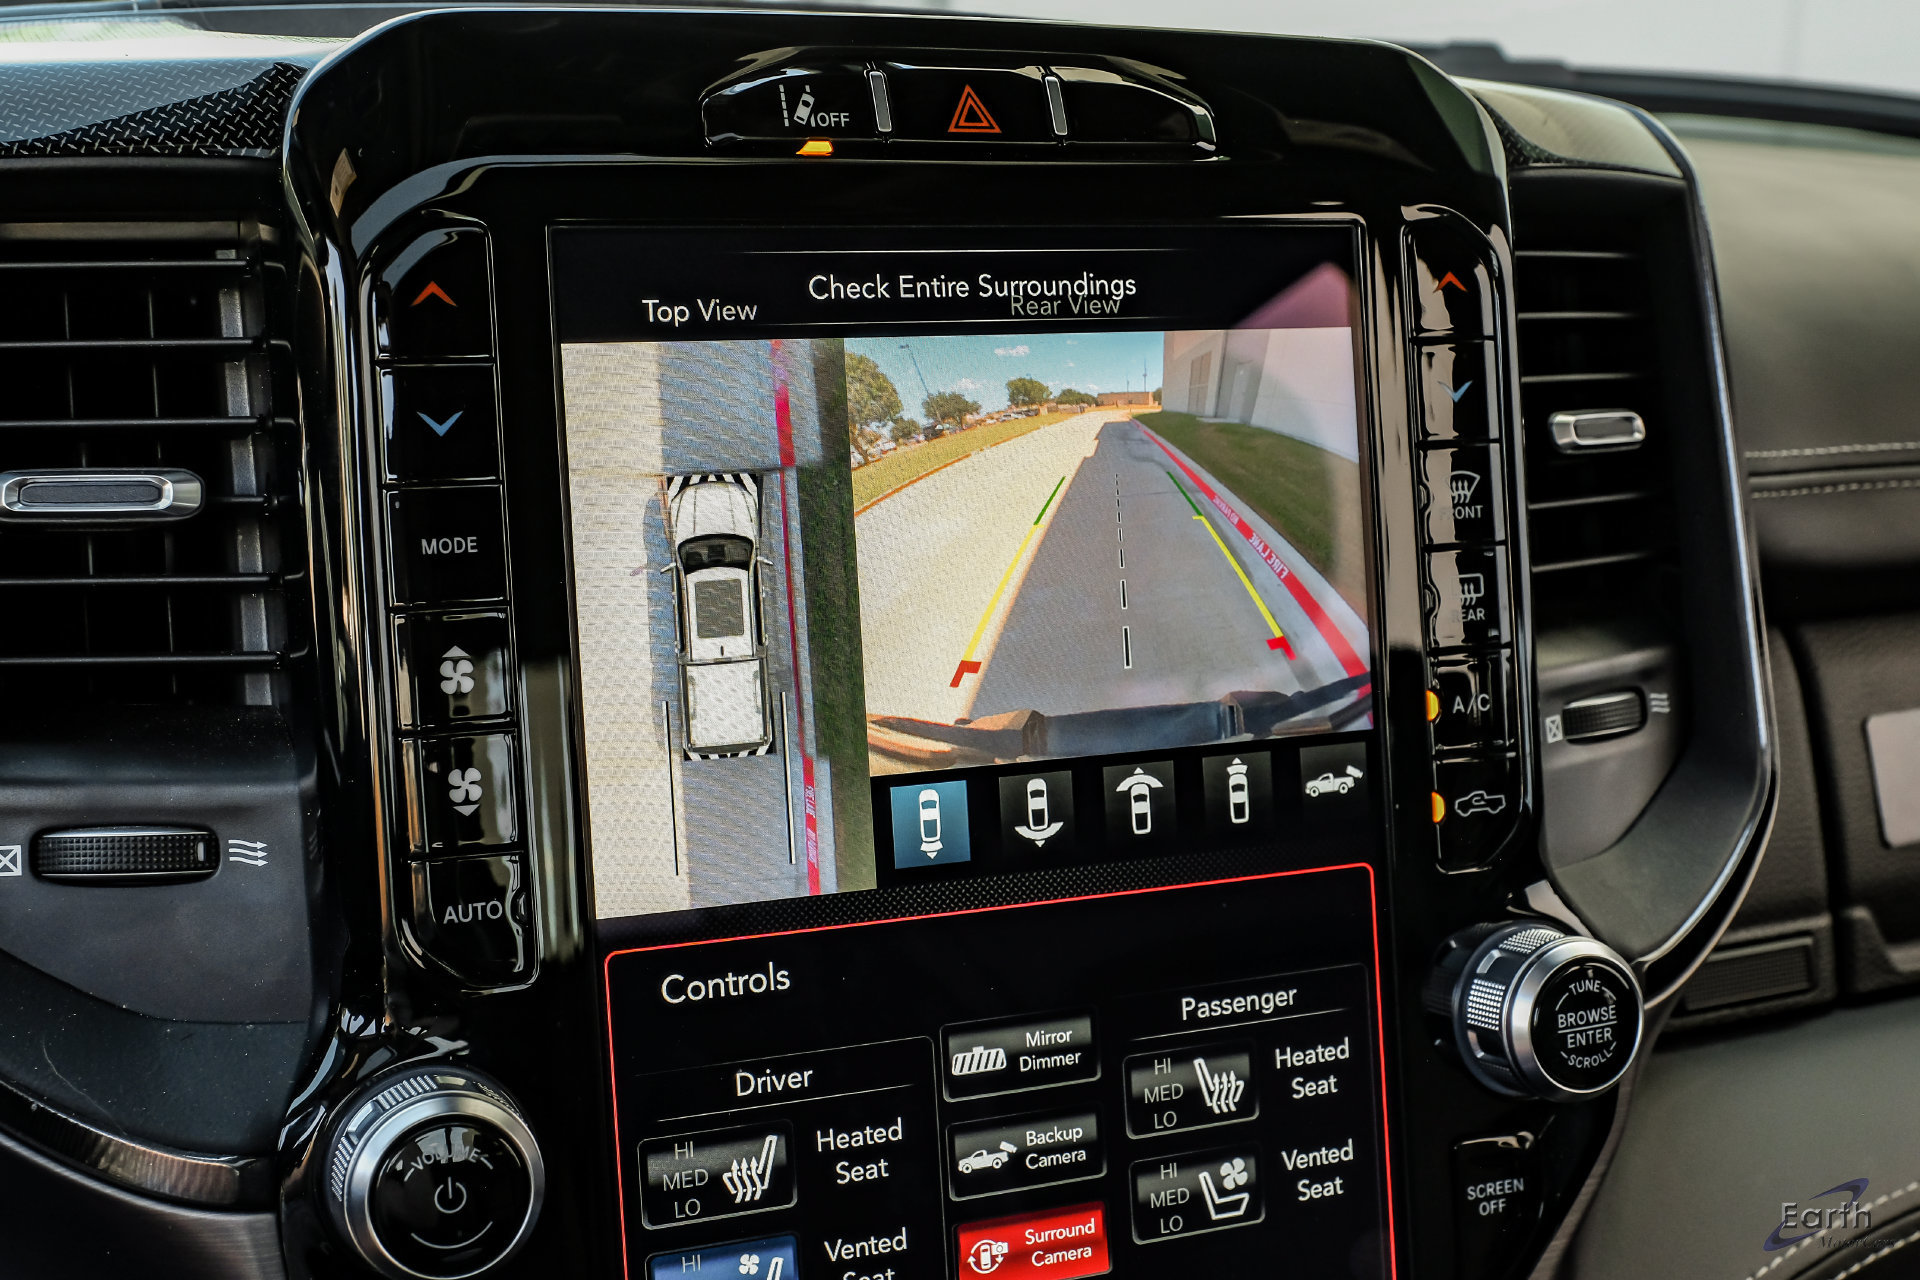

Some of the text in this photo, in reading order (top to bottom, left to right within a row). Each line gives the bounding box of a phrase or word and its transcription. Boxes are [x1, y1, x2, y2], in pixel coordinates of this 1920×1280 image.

[817, 111, 850, 128] OFF
[808, 271, 1137, 300] Check Entire Surroundings
[641, 298, 758, 328] Top View
[1011, 294, 1121, 316] Rear View
[421, 536, 479, 555] MODE
[1452, 694, 1491, 714] A/C
[443, 900, 503, 925] AUTO
[660, 961, 792, 1005] Controls
[1568, 979, 1602, 996] TUNE
[1180, 987, 1298, 1021] Passenger
[1557, 1004, 1618, 1029] BROWSE
[1025, 1028, 1073, 1049] Mirror
[1566, 1027, 1614, 1049] ENTER
[1018, 1051, 1082, 1073] Dimmer
[1275, 1037, 1351, 1070] Heated
[1567, 1050, 1614, 1069] SCROLL
[1153, 1057, 1172, 1076] HI
[735, 1068, 814, 1097] Driver
[1143, 1083, 1184, 1104] MED
[1291, 1073, 1339, 1099] Seat
[1153, 1110, 1178, 1130] LO
[815, 1117, 904, 1152] Heated
[1025, 1125, 1084, 1149] Backup
[673, 1141, 695, 1160] HI
[1025, 1147, 1087, 1171] Camera
[1281, 1139, 1355, 1172] Vented
[662, 1169, 710, 1193] MED
[835, 1159, 890, 1186] Seat
[1159, 1162, 1179, 1181] HI
[1149, 1187, 1191, 1209] MED
[1297, 1175, 1345, 1203] Seat
[1466, 1178, 1525, 1201] SCREEN
[674, 1199, 701, 1219] LO
[1479, 1198, 1507, 1217] OFF
[1025, 1218, 1096, 1246] Surround
[1159, 1214, 1184, 1235] LO
[823, 1226, 908, 1262] Vented
[681, 1255, 702, 1274] HI
[1031, 1245, 1093, 1270] Camera
